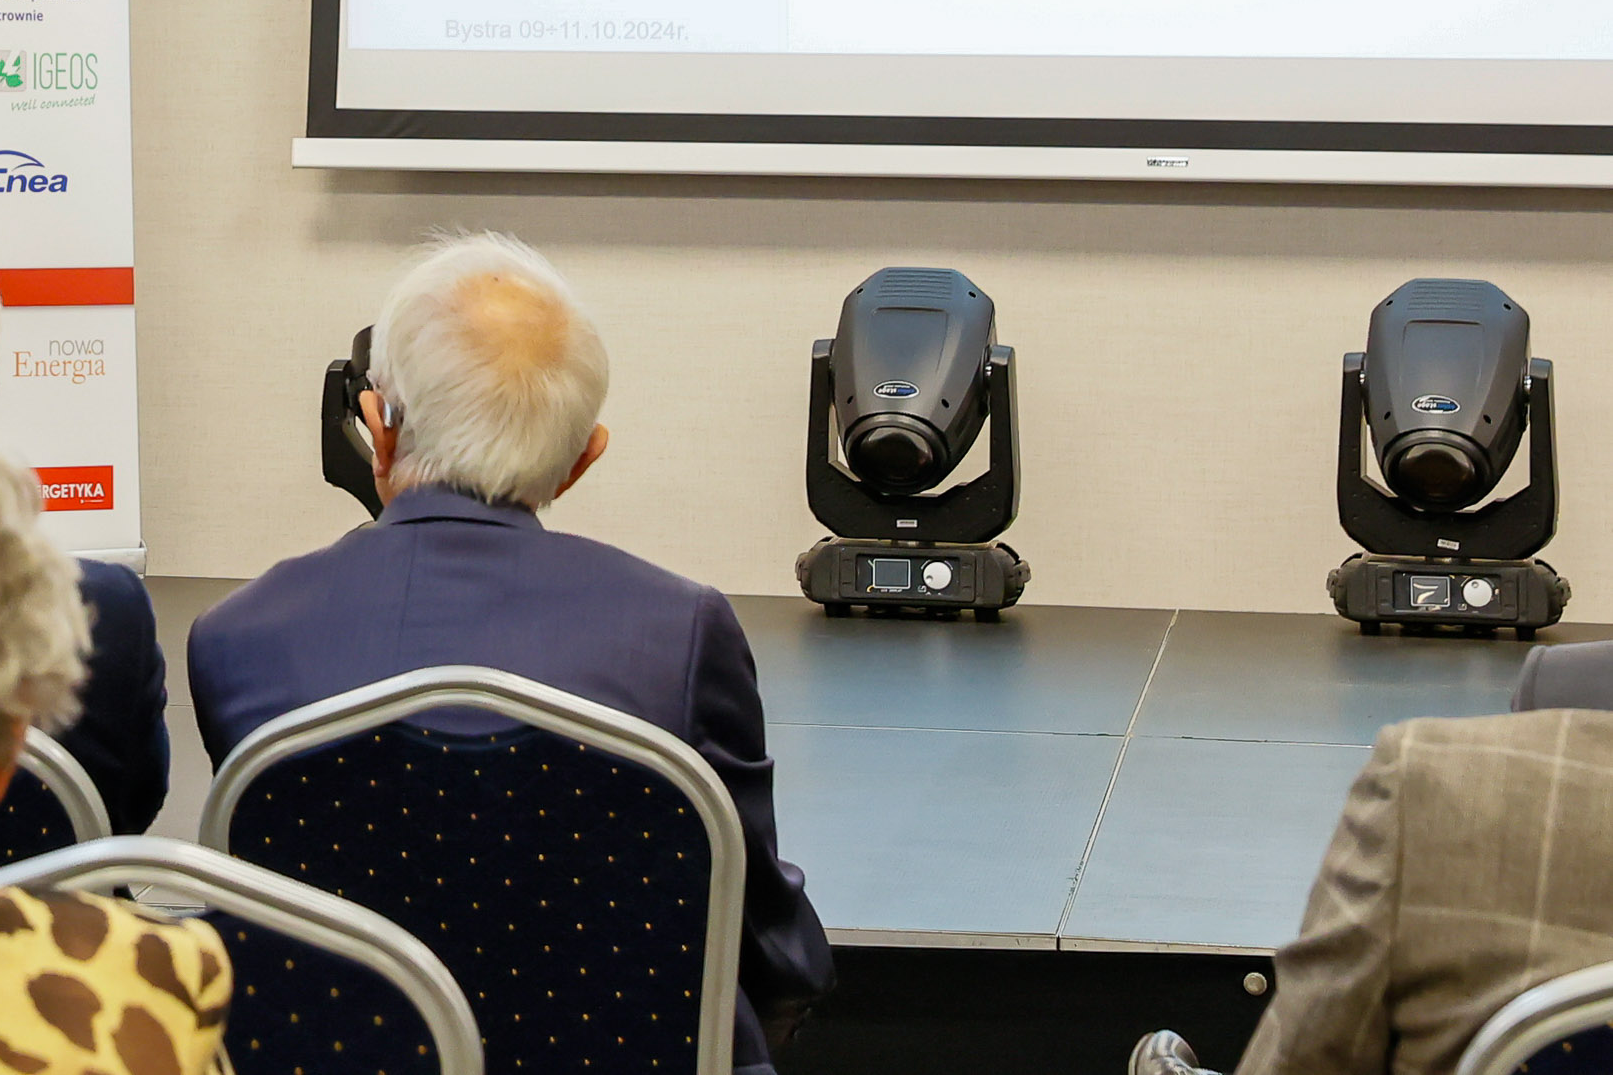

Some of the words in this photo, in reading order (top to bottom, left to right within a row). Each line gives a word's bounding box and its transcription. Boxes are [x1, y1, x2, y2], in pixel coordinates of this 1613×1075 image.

[445, 19, 512, 42] Bystra
[33, 52, 99, 90] IGEOS
[40, 94, 96, 109] connected
[12, 351, 106, 384] Energia
